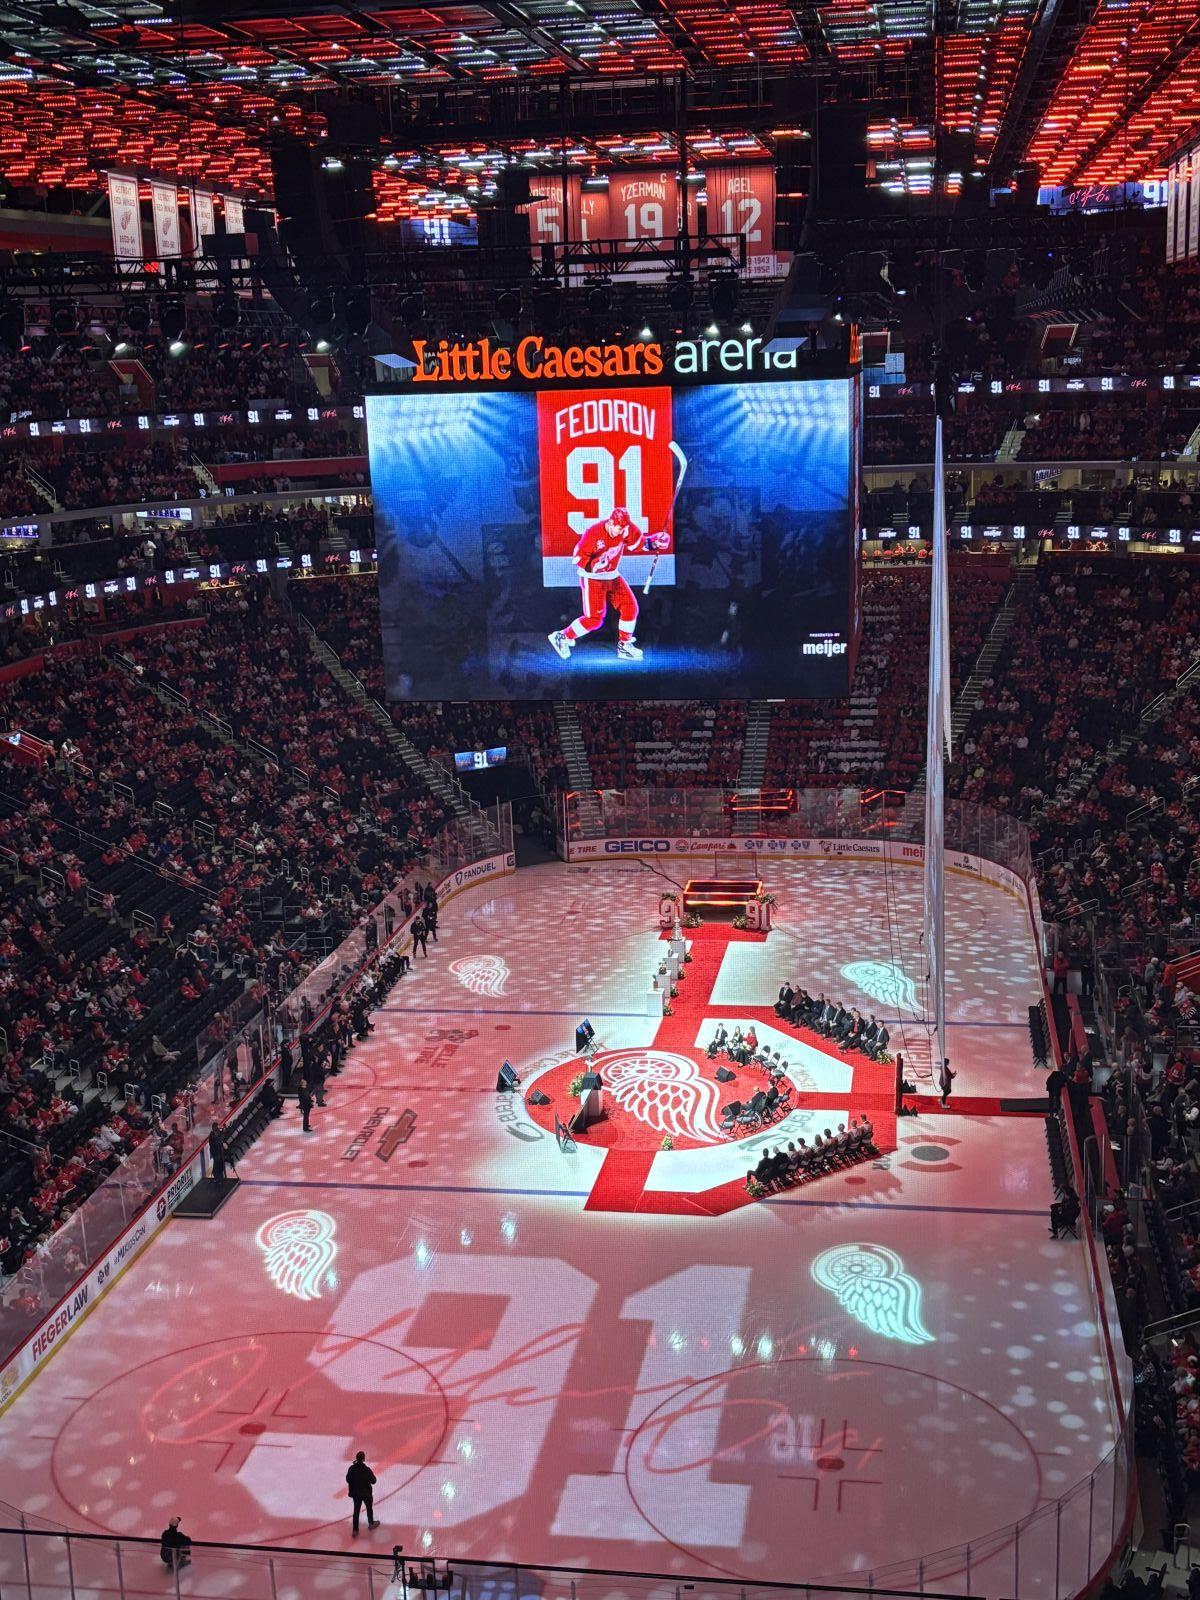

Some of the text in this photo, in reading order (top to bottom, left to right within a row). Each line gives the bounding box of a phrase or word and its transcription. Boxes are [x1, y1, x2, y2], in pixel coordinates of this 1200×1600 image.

[621, 182, 666, 201] YZERMAN
[728, 177, 754, 195] ABEL
[1143, 180, 1168, 203] 91
[624, 202, 663, 247] 19
[721, 197, 761, 243] 12
[412, 336, 797, 382] Little Caesars arena
[990, 381, 1003, 393] 91
[1038, 379, 1051, 393] 91
[1101, 377, 1114, 391] 91
[1163, 376, 1175, 389] 91
[868, 385, 881, 398] 91
[247, 410, 260, 423] 91
[307, 407, 320, 421] 91
[353, 405, 364, 419] 91
[79, 419, 91, 433] 91
[137, 416, 150, 429] 91
[193, 413, 205, 426] 91
[555, 399, 656, 445] FEDOROV
[29, 422, 40, 437] 91
[566, 445, 649, 535] 91
[908, 526, 920, 539] 91
[960, 525, 973, 539] 91
[1013, 525, 1026, 539] 91
[1067, 526, 1080, 539] 91
[1118, 527, 1130, 541] 91
[1169, 529, 1181, 543] 91
[301, 553, 313, 567] 91
[349, 549, 361, 563] 91
[209, 564, 221, 578] 91
[256, 559, 268, 572] 91
[126, 576, 137, 591] 91
[165, 570, 175, 584] 91
[48, 590, 58, 606] 91
[85, 583, 97, 599] 91
[20, 599, 30, 615] 91
[802, 639, 848, 658] meijer
[473, 751, 489, 769] 91
[578, 845, 598, 854] TIRE
[605, 840, 671, 853] GEICO
[833, 843, 881, 853] Little Caesars
[463, 861, 497, 881] FANDUEL
[745, 899, 773, 932] 91
[340, 1107, 391, 1163] CHEVROLET
[166, 1166, 194, 1201] PRIORITY
[235, 1251, 753, 1548] 91
